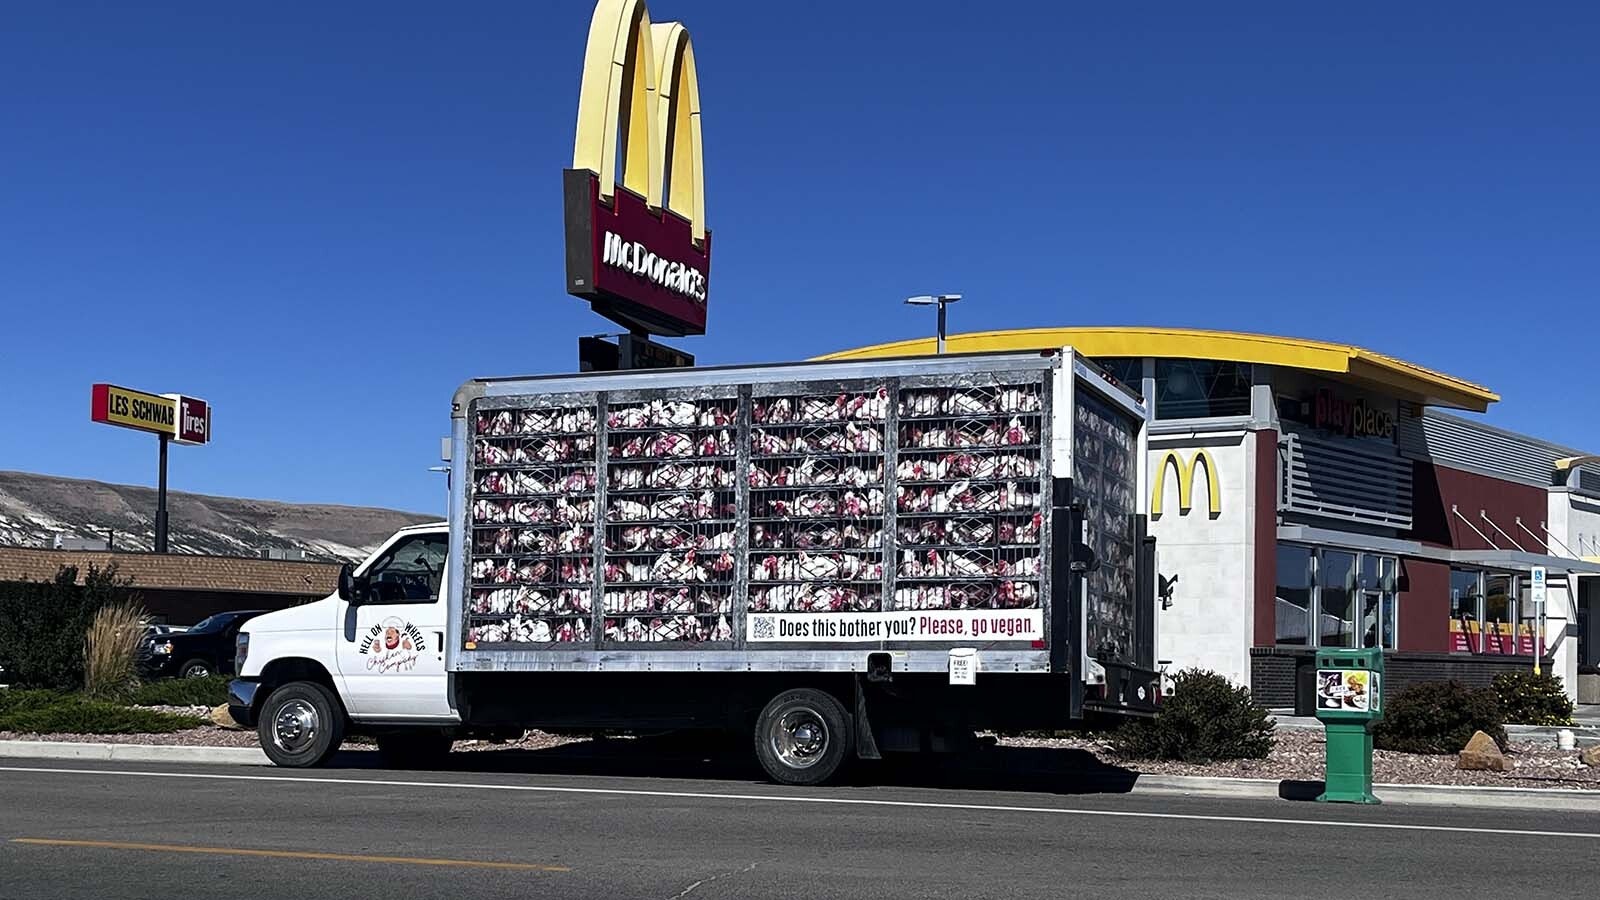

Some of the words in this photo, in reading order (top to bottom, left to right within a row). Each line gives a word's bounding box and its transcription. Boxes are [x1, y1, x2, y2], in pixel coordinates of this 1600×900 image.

[110, 394, 129, 416] LES
[132, 399, 175, 425] SCHWAB
[182, 402, 205, 434] Tires
[359, 635, 374, 655] HELL
[370, 623, 382, 636] ON
[404, 622, 426, 651] WHEELS
[779, 618, 809, 637] Does
[812, 618, 836, 637] this
[839, 618, 881, 637] bother
[885, 616, 917, 638] you?
[920, 616, 968, 636] Please,
[972, 619, 987, 637] go
[991, 617, 1036, 636] vegan.
